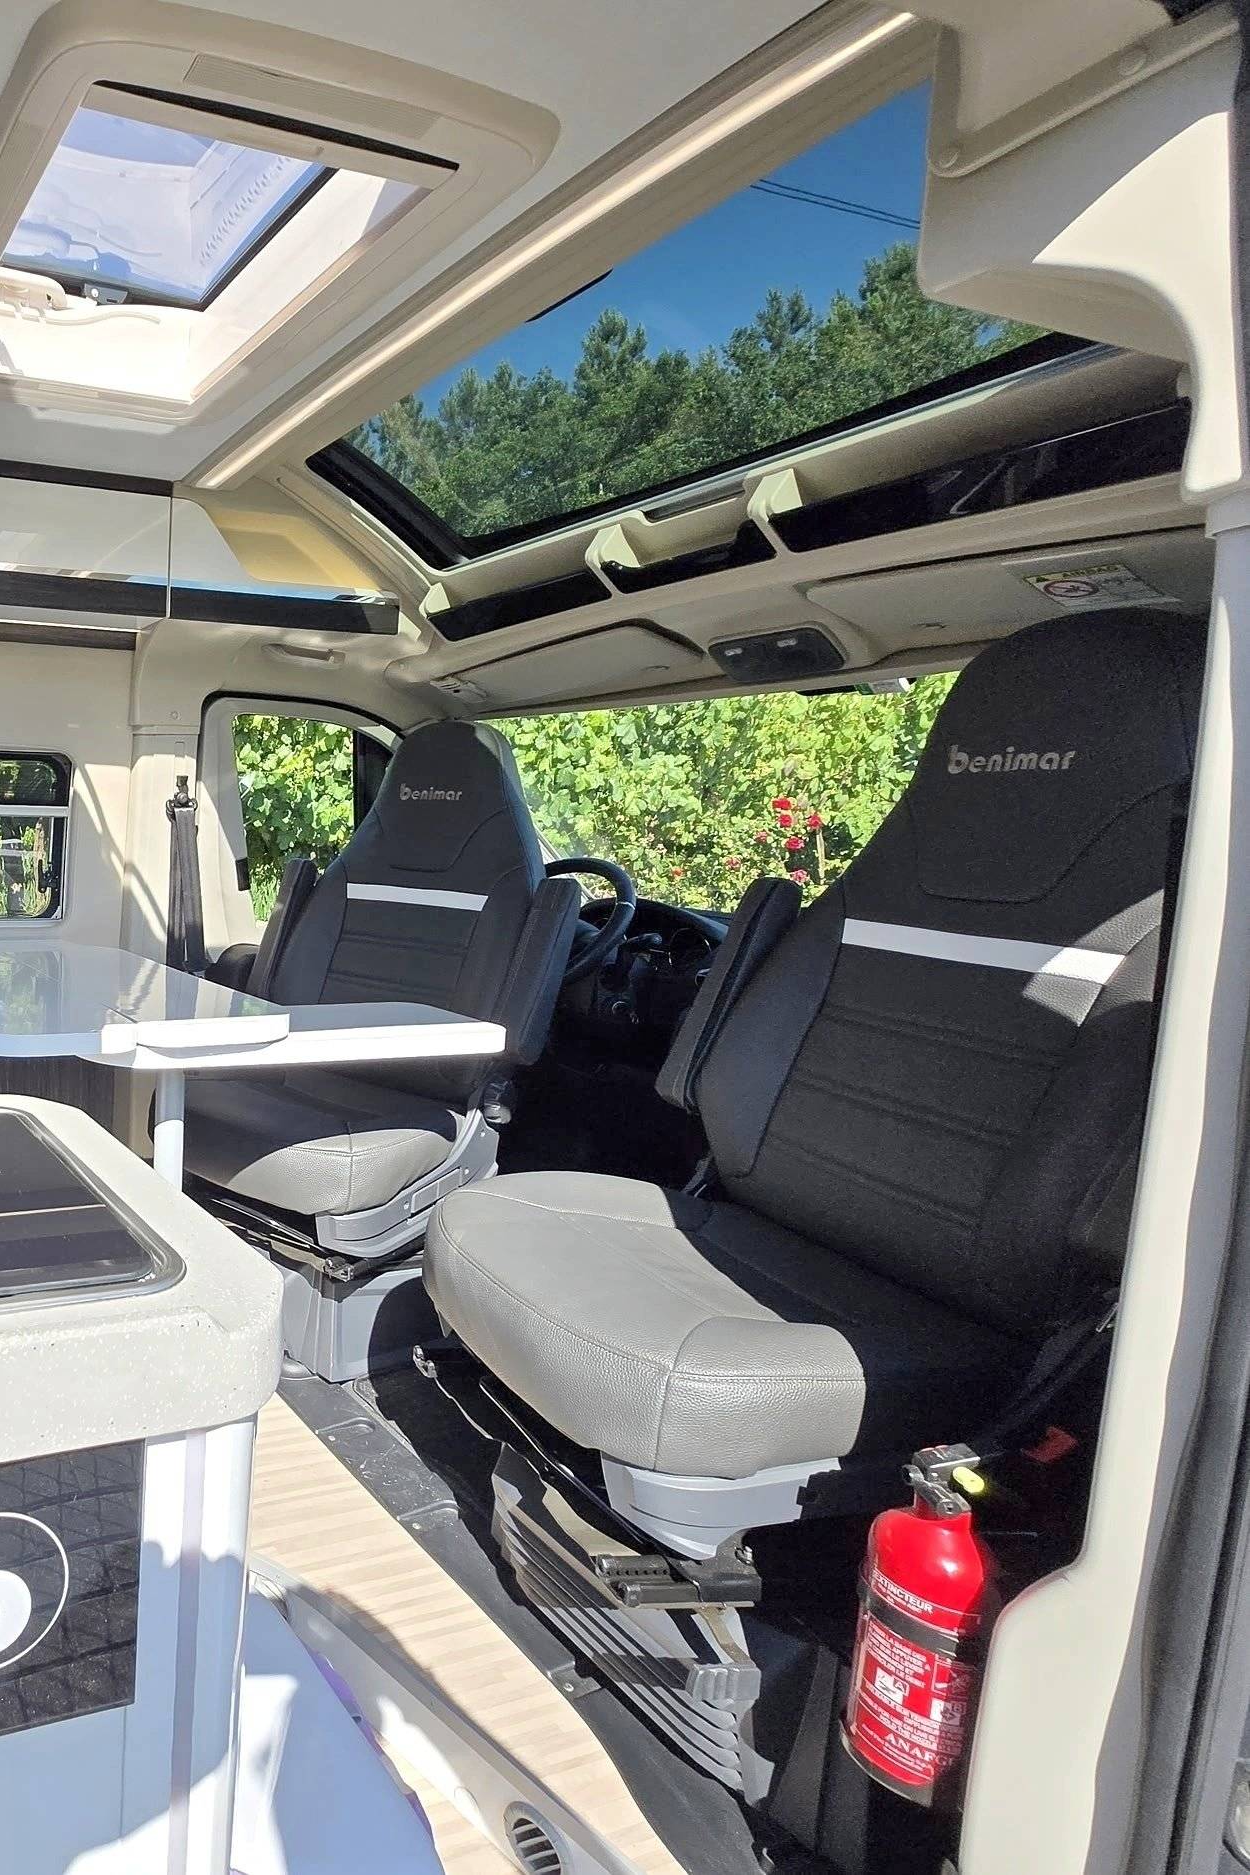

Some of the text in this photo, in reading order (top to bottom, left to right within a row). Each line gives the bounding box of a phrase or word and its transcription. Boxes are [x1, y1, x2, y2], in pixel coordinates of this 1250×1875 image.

[1062, 564, 1120, 578] AIRBAG
[948, 744, 1076, 774] benimar
[399, 783, 463, 801] benimar
[873, 1570, 934, 1613] EXTINCTEUR
